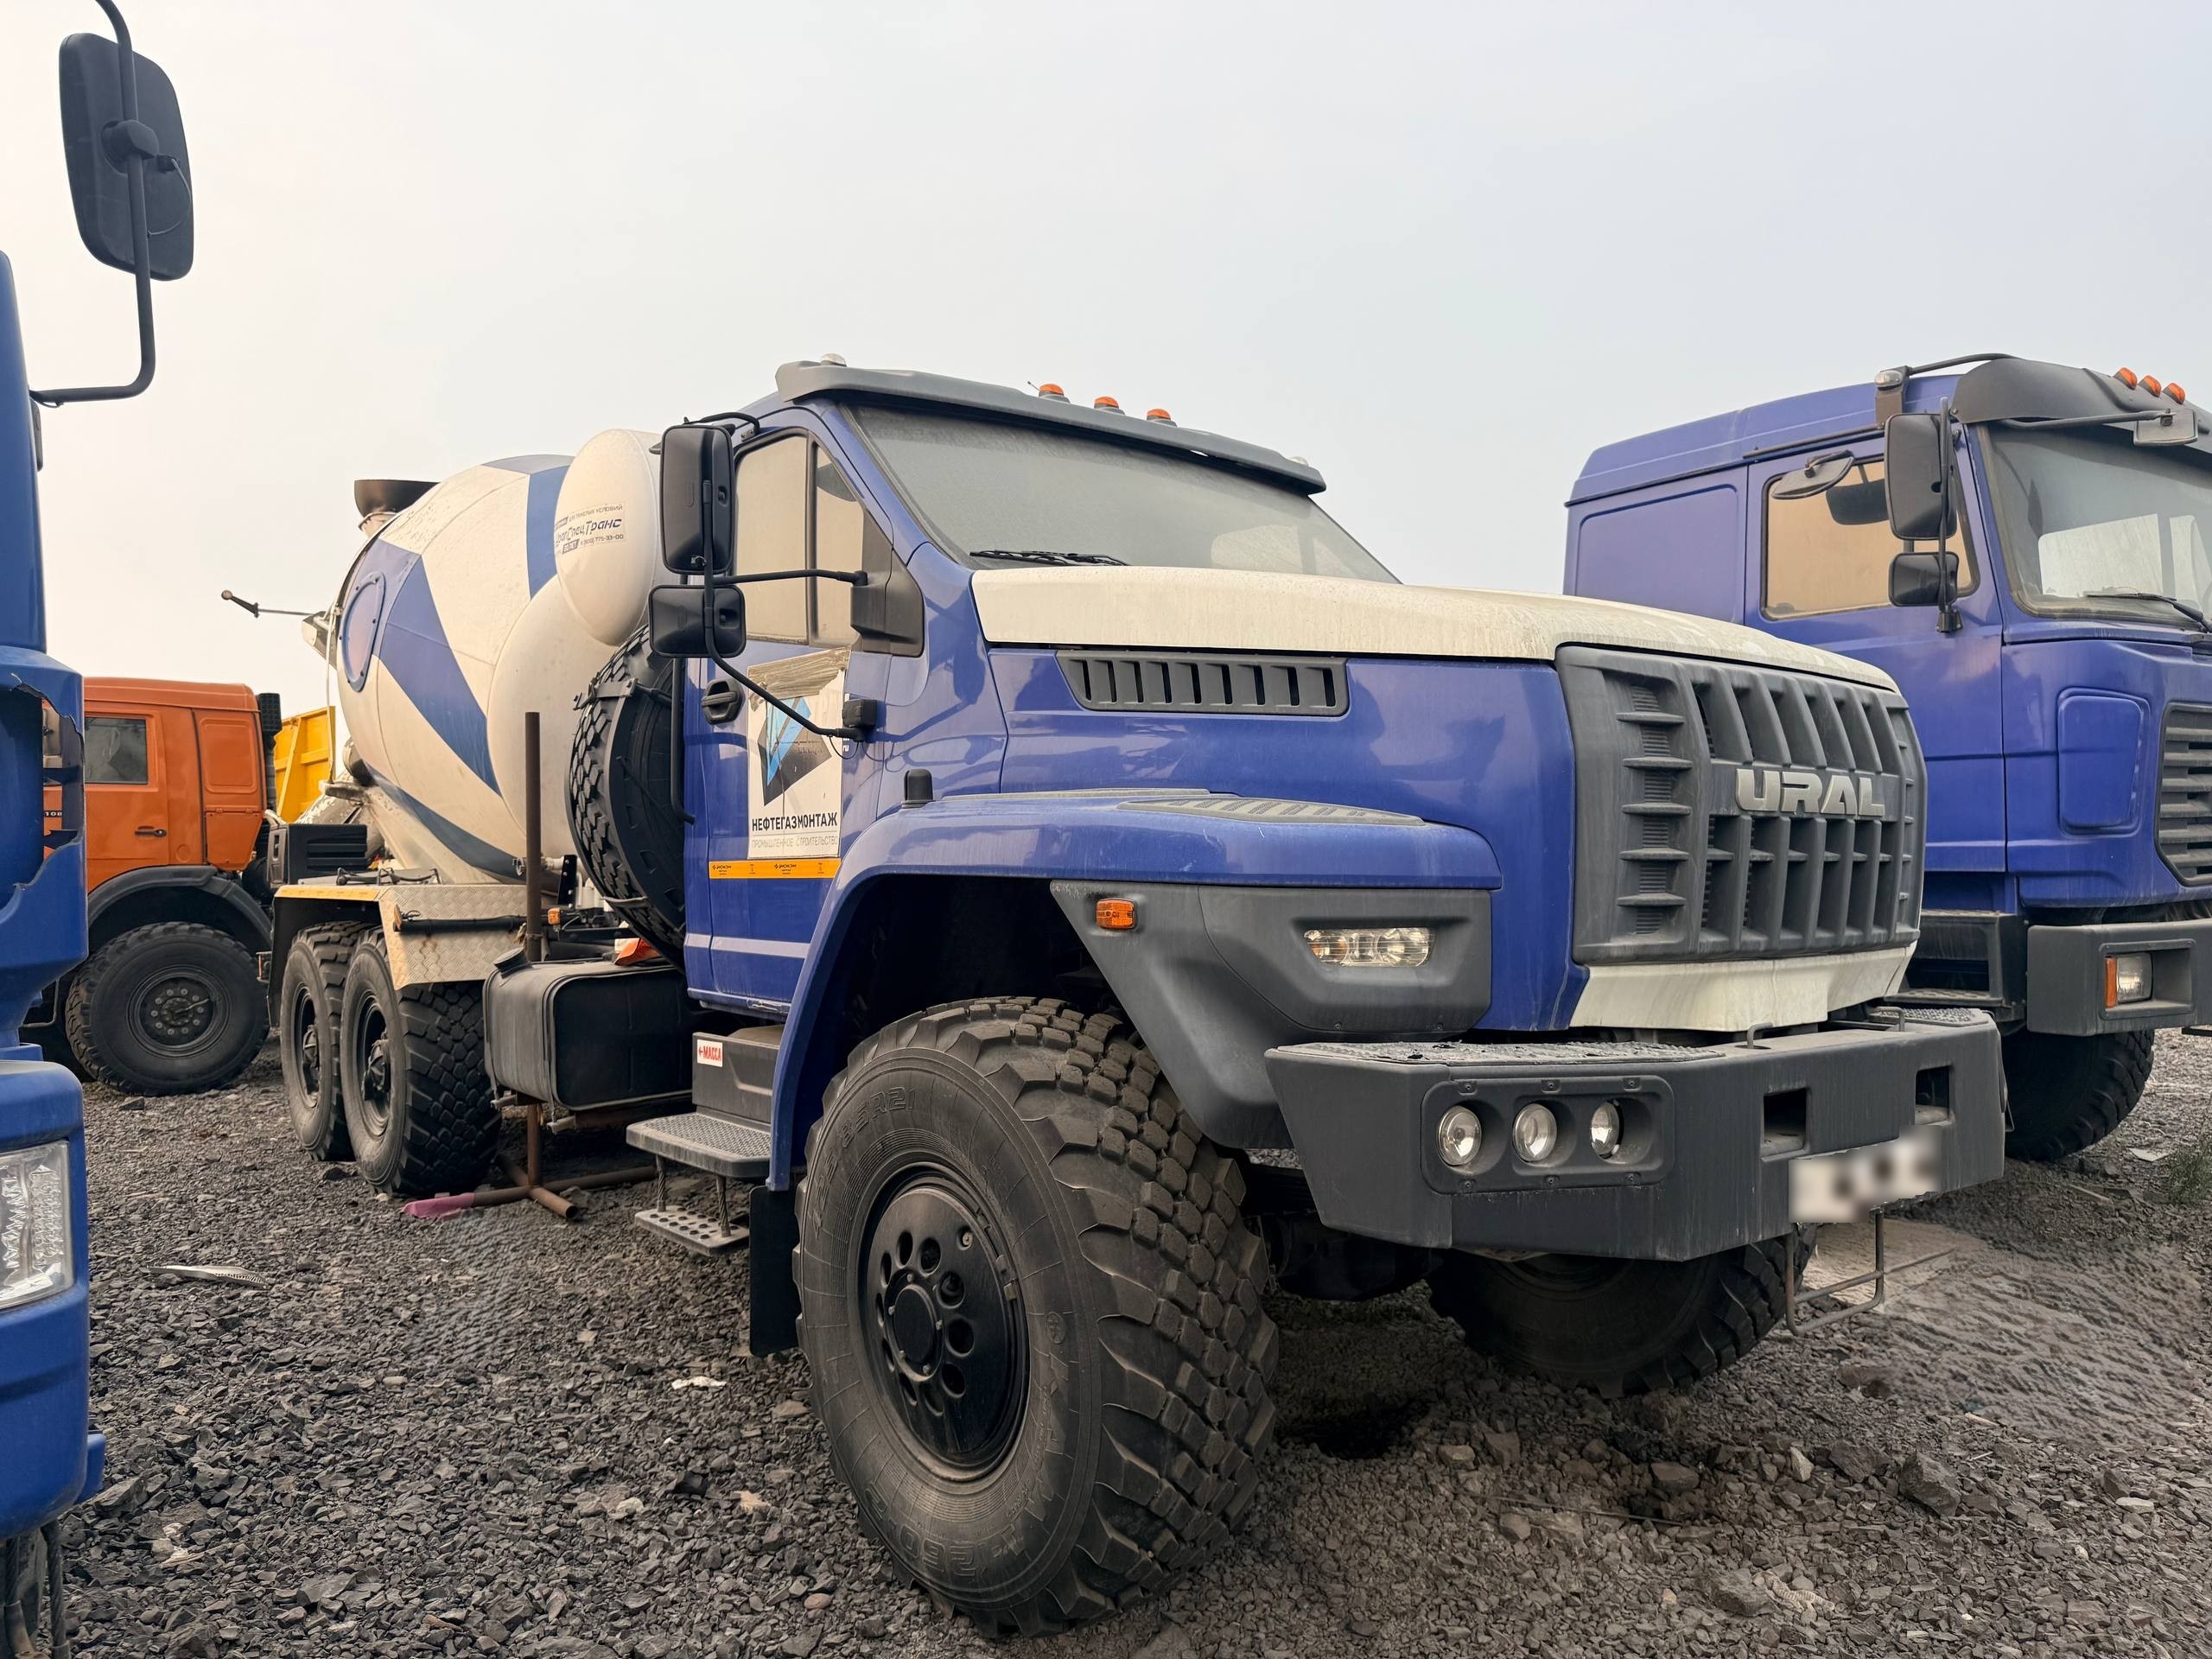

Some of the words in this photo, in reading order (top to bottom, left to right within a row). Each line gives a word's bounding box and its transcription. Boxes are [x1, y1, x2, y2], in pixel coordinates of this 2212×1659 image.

[1736, 768, 1885, 816] URAL
[752, 812, 838, 831] НЕФТЕГАЗМОНТАЖ
[751, 838, 793, 849] ПРОМЫШЛЕННОЕ
[796, 836, 838, 848] СТРОИТЕЛЬСТВО
[703, 1046, 721, 1061] МАССА
